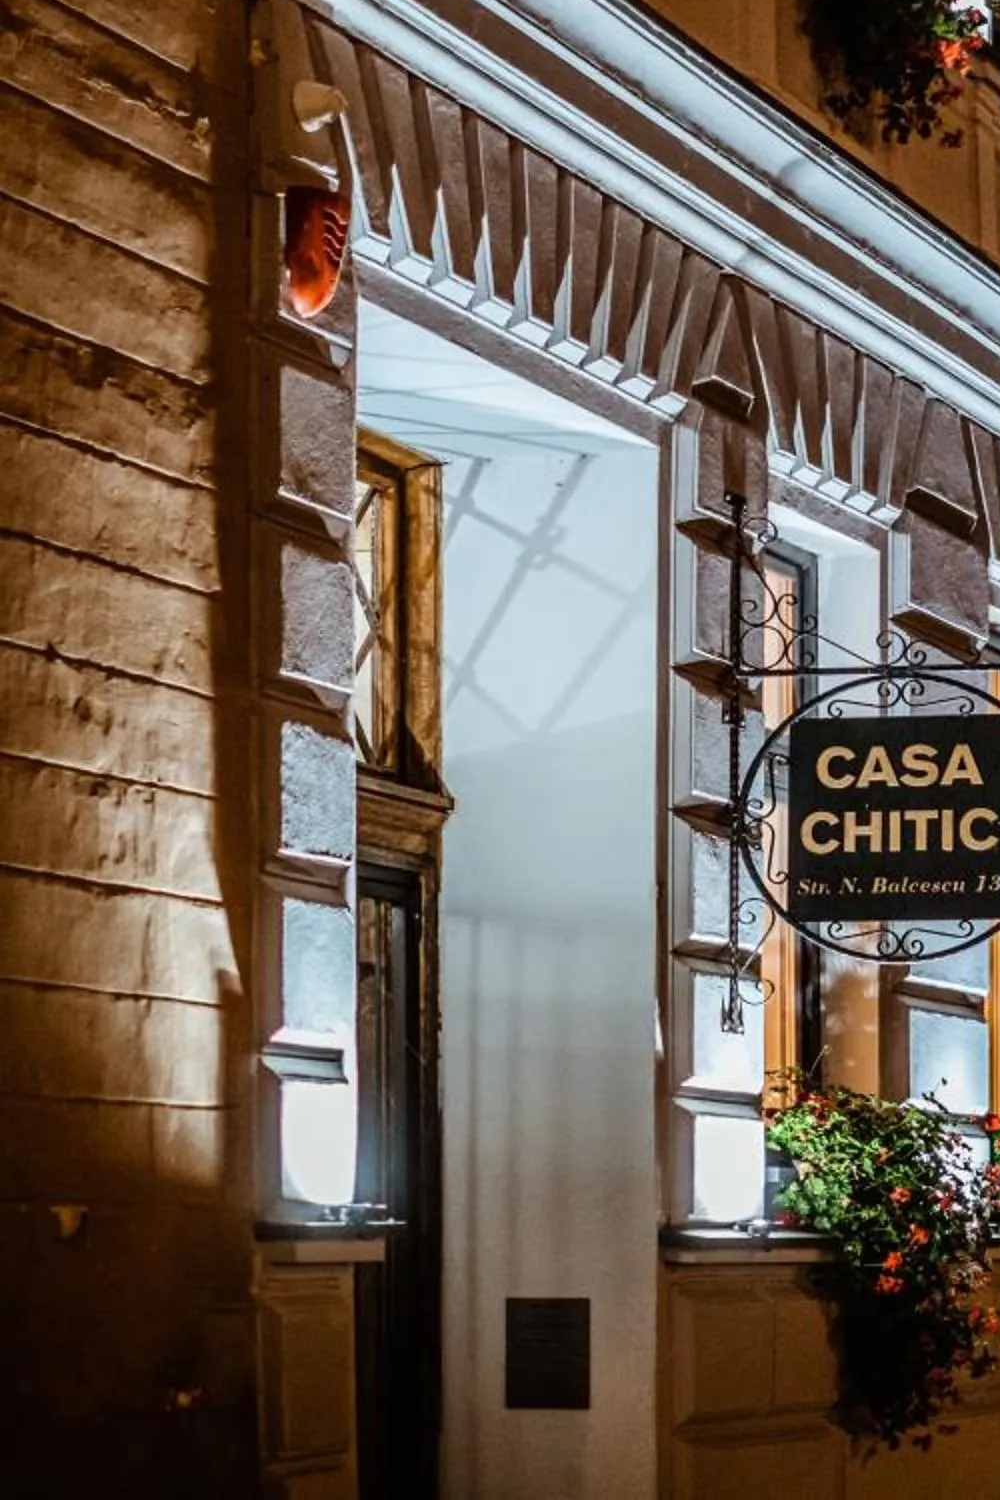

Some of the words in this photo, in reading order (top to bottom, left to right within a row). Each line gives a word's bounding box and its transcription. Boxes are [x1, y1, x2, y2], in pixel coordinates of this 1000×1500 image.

[815, 743, 984, 789] CASA
[800, 807, 1000, 855] CHITIC
[797, 878, 830, 895] Str.
[839, 876, 862, 894] N.
[871, 876, 966, 893] Balcescu
